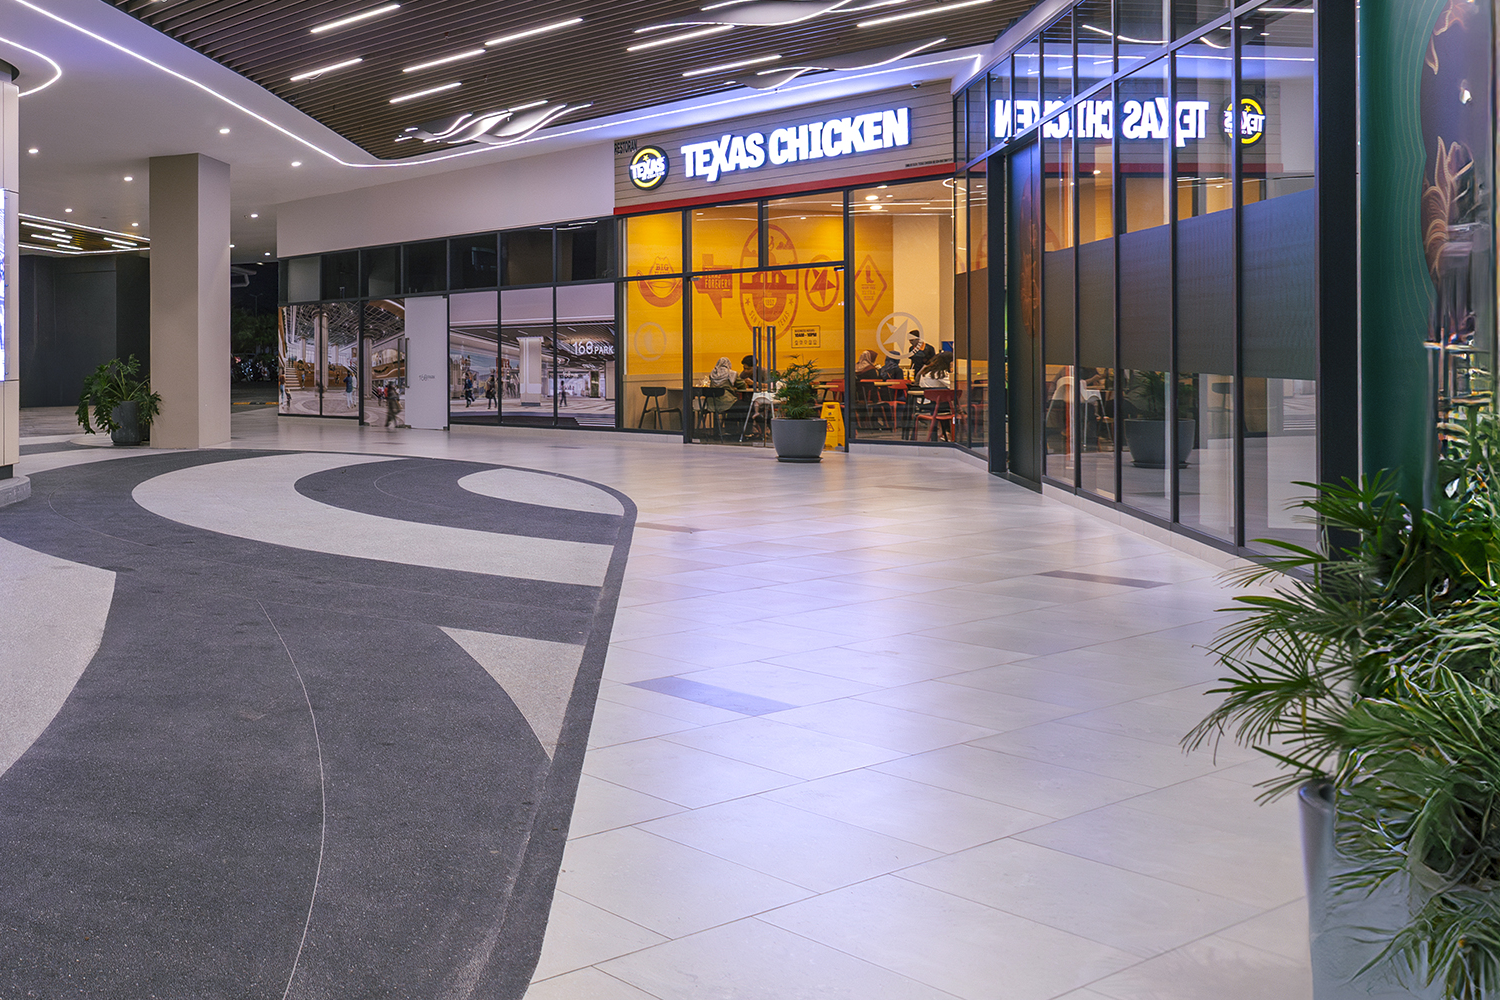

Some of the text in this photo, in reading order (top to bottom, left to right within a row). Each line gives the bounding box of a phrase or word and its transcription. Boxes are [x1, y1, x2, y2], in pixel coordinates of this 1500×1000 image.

[680, 107, 910, 183] TEXAS CHICKEN
[630, 156, 667, 181] TEXAS
[655, 263, 670, 272] BIG
